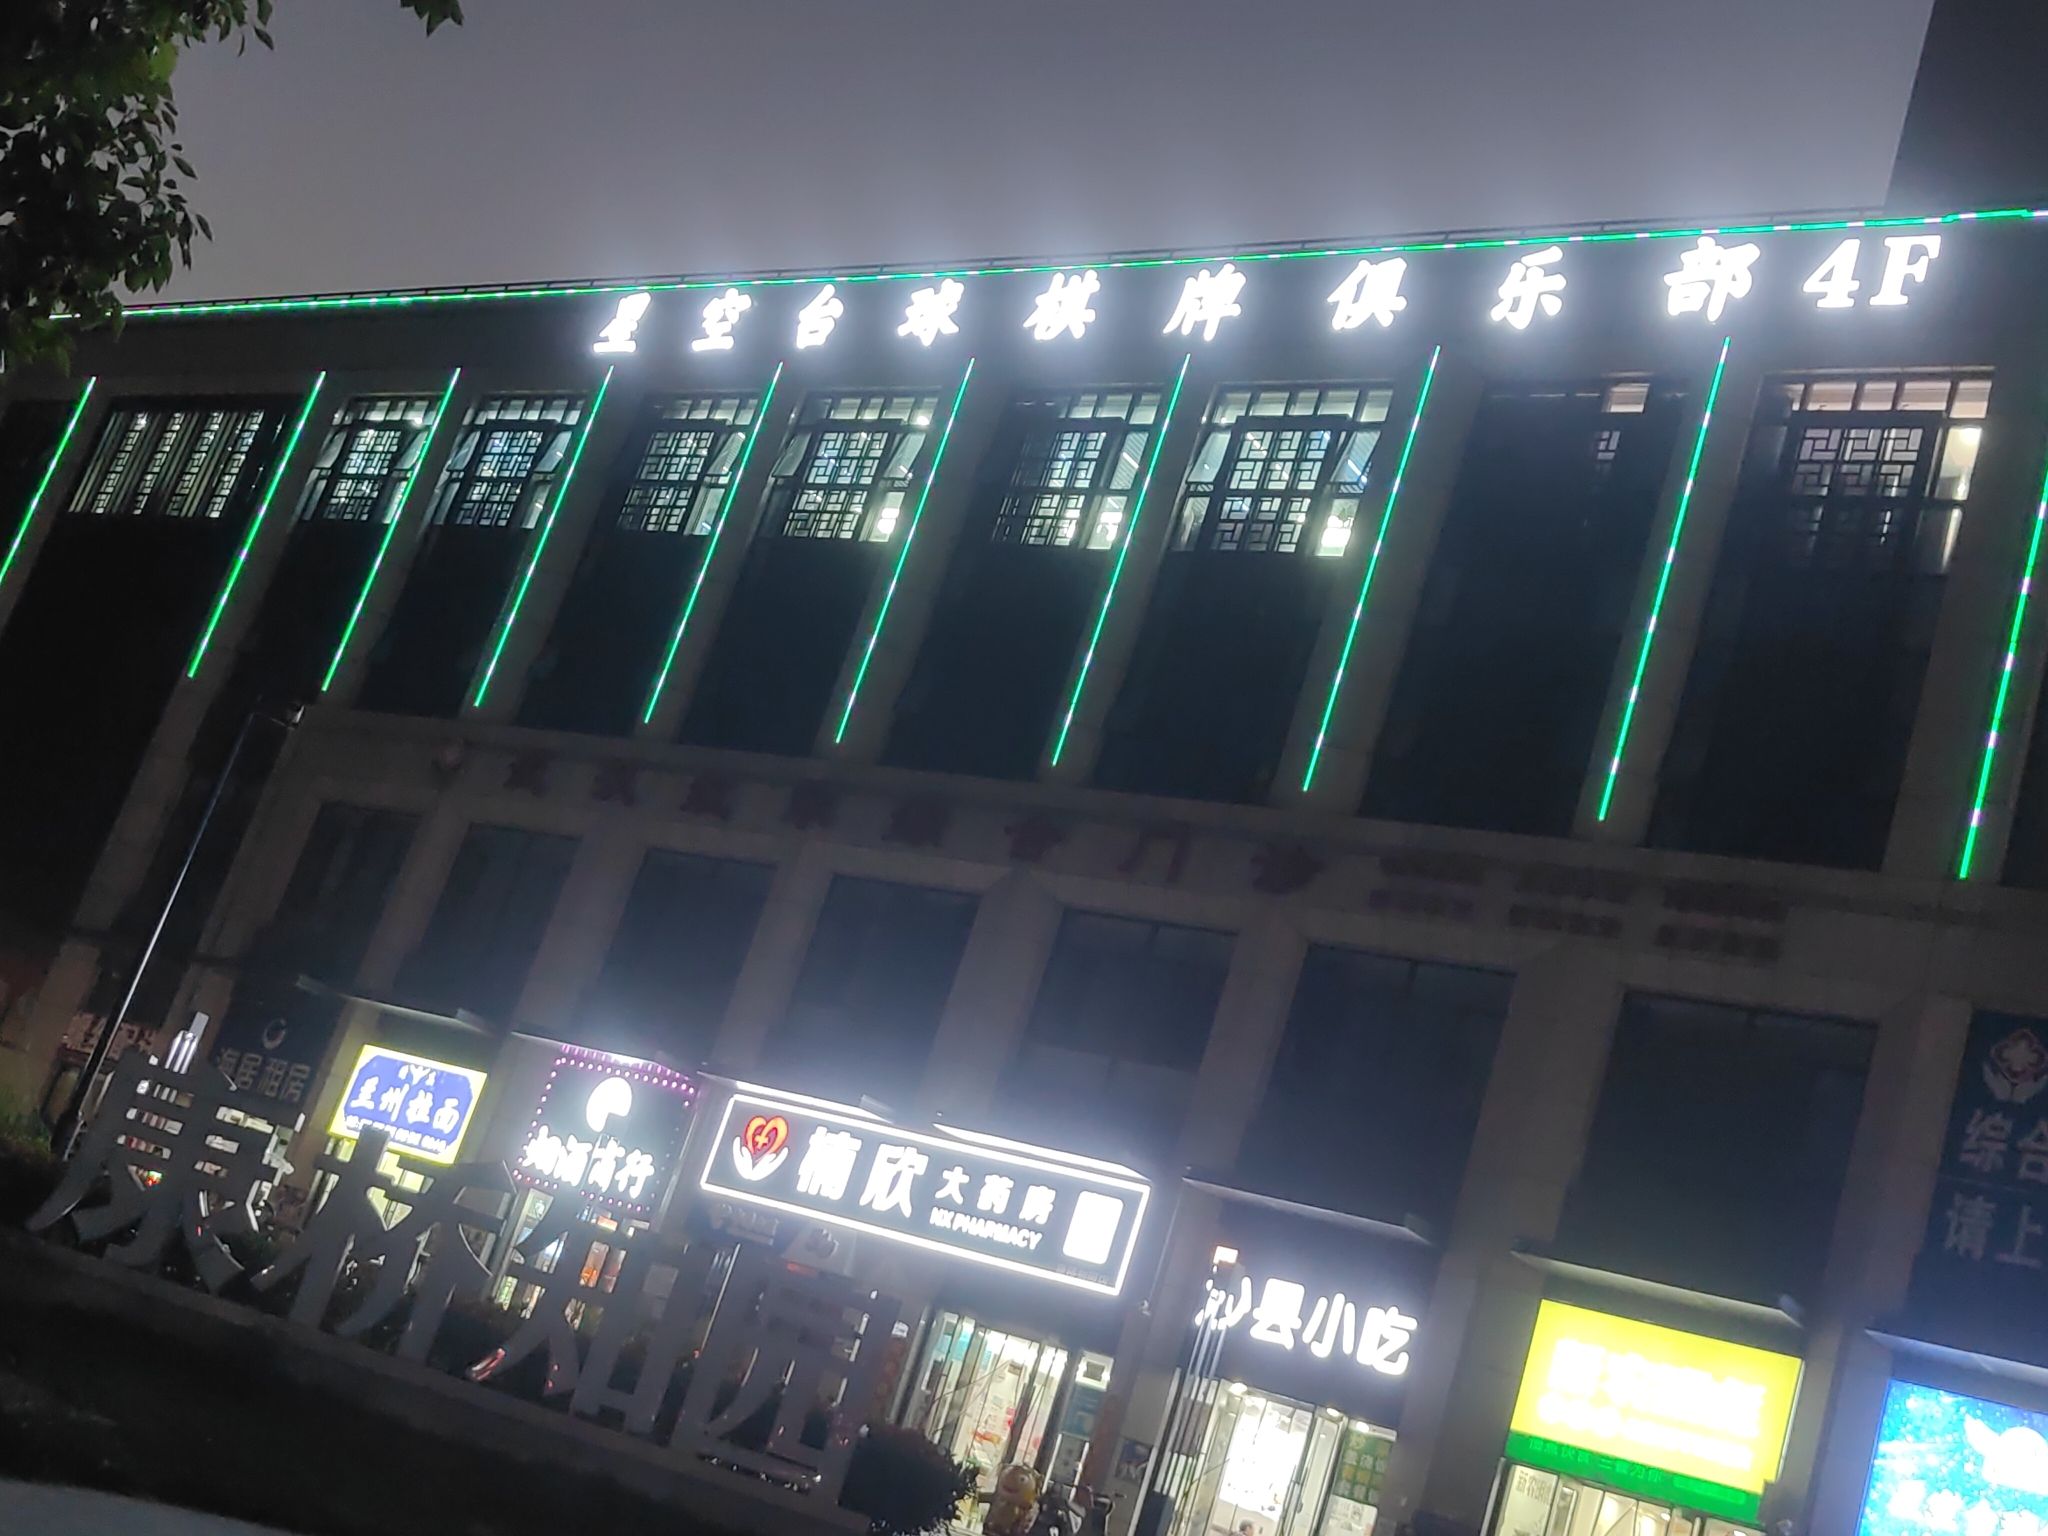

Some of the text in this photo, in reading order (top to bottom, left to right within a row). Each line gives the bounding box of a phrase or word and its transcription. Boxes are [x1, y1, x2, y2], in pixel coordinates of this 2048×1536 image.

[350, 1076, 460, 1135] 兰州拉面
[521, 1124, 656, 1200] 烟酒商行
[951, 1212, 1043, 1251] PHARMACY
[1194, 1275, 1419, 1376] 沙县小吃
